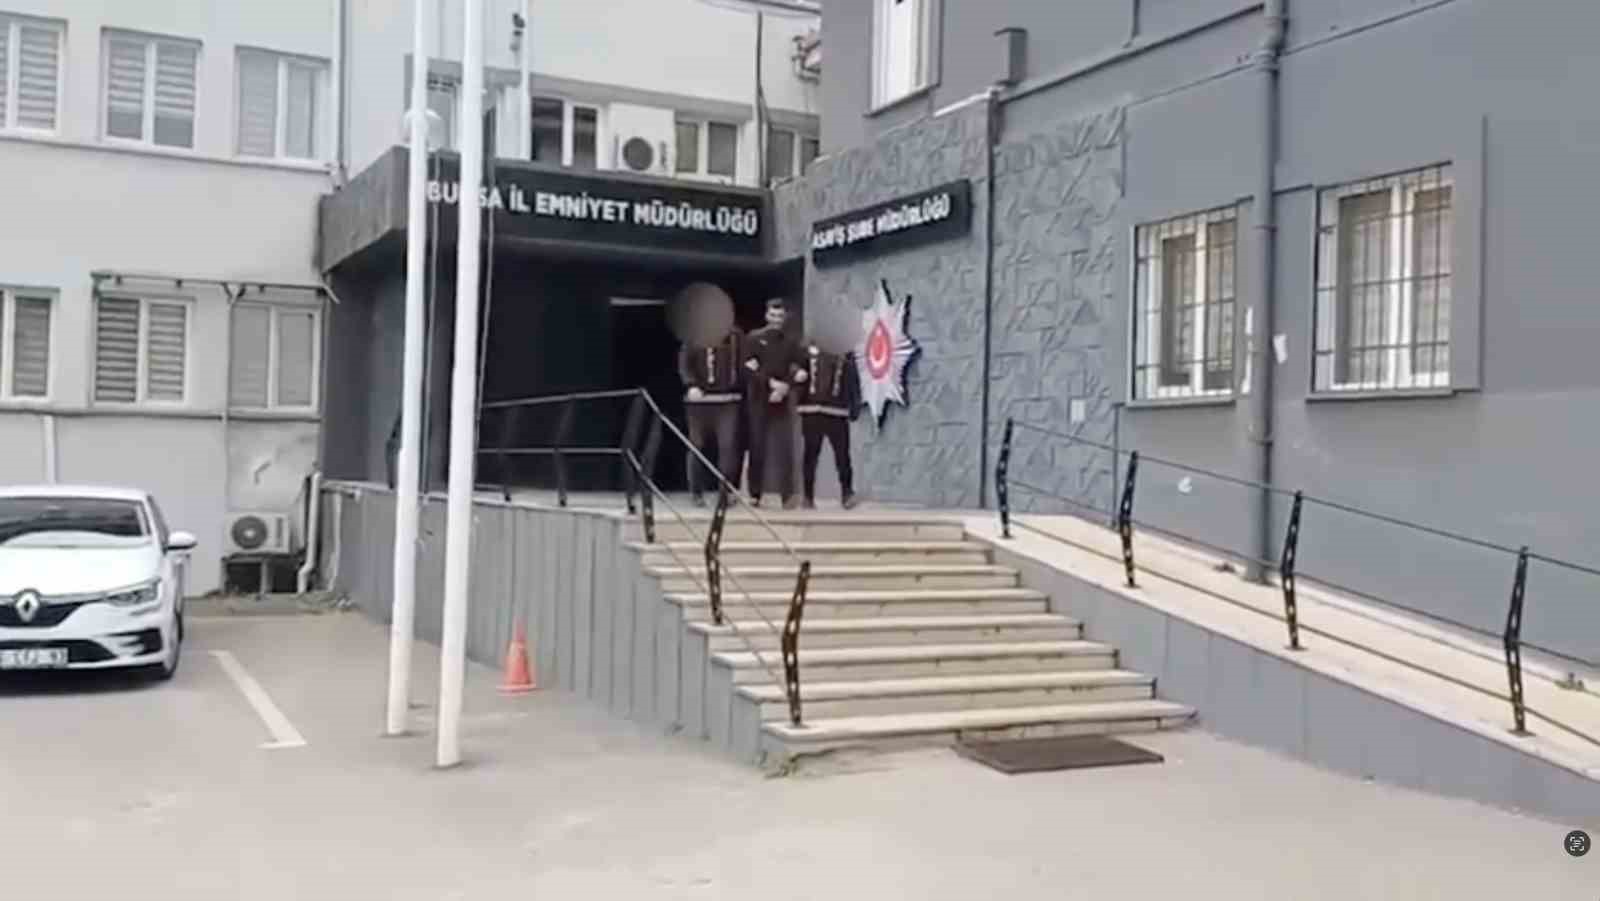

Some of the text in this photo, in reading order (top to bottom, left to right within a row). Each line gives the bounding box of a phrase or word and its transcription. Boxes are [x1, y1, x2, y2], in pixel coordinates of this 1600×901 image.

[427, 180, 758, 235] BUSA İL EMNİYET MÜDÜRLÜĞÜ
